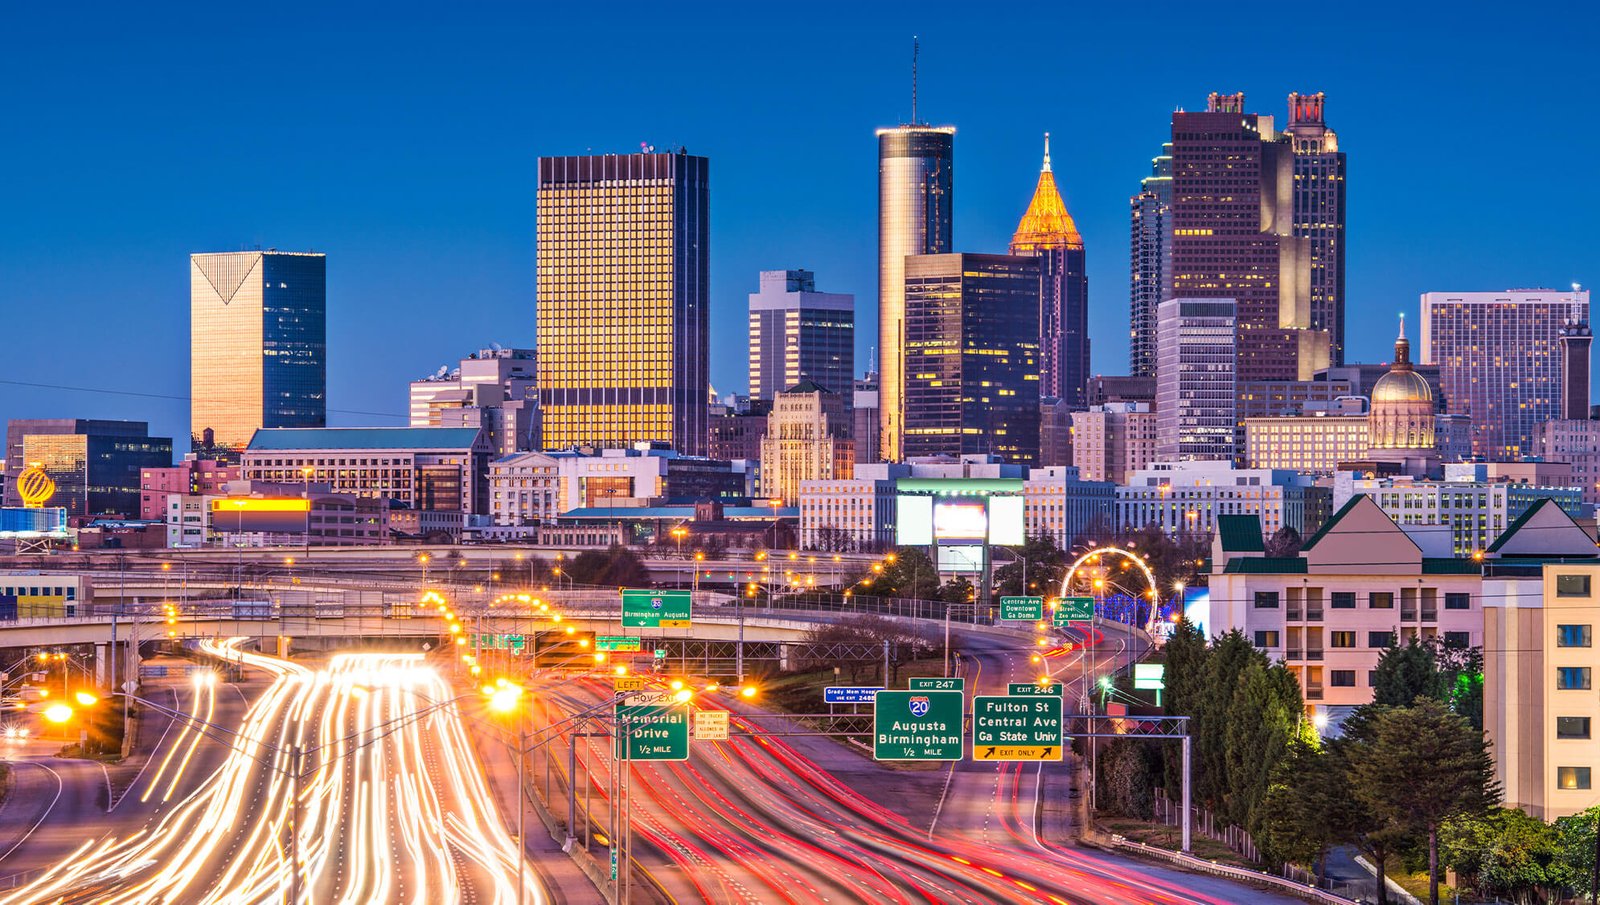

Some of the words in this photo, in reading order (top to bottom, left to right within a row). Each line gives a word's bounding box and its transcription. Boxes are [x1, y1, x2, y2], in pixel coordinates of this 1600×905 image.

[624, 611, 660, 619] Birmingham
[664, 611, 688, 619] Augusta
[936, 680, 954, 688] 247
[912, 701, 928, 712] 20
[986, 702, 1028, 712] Fulton
[1036, 702, 1049, 712] St
[621, 714, 682, 724] Memorial
[978, 716, 1026, 726] Central
[1034, 716, 1058, 726] Ave
[892, 720, 946, 734] Augusta
[634, 728, 669, 738] Drive
[978, 732, 992, 742] Ga
[1000, 732, 1028, 742] State
[1034, 732, 1057, 742] Univ
[880, 734, 959, 747] Birmingham
